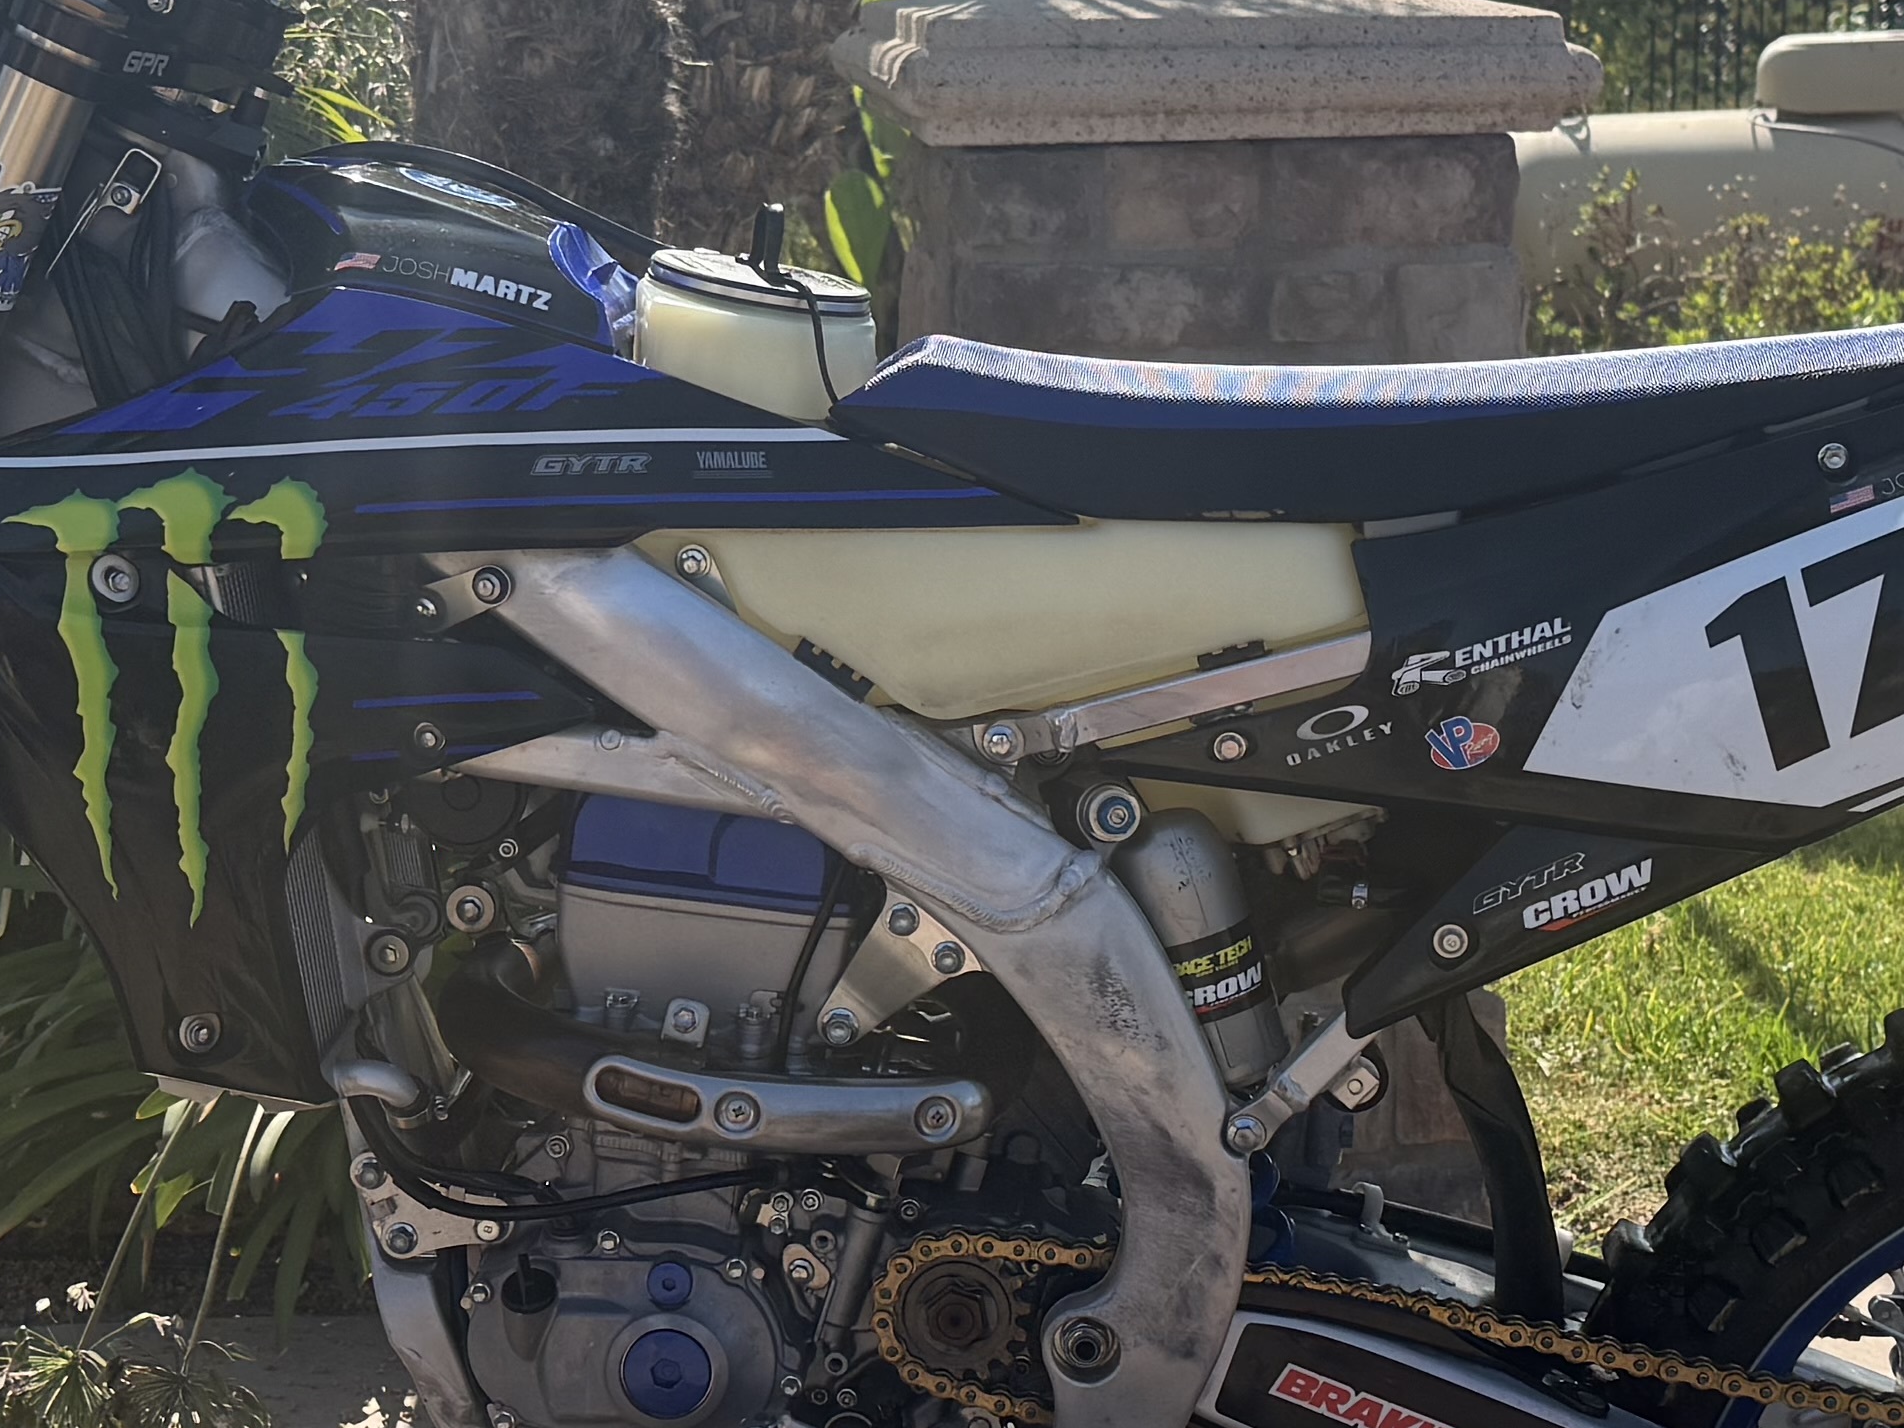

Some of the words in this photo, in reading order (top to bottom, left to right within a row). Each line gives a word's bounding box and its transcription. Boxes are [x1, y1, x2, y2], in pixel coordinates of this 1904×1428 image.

[123, 50, 170, 77] GPR
[532, 454, 652, 475] GYTR
[696, 451, 768, 469] YAMALUBE
[1470, 634, 1572, 675] CHAINWHEELS
[1286, 721, 1394, 766] OAKLEY
[1425, 716, 1475, 769] VP
[1473, 851, 1586, 915] GYTR
[1522, 857, 1653, 930] CROW
